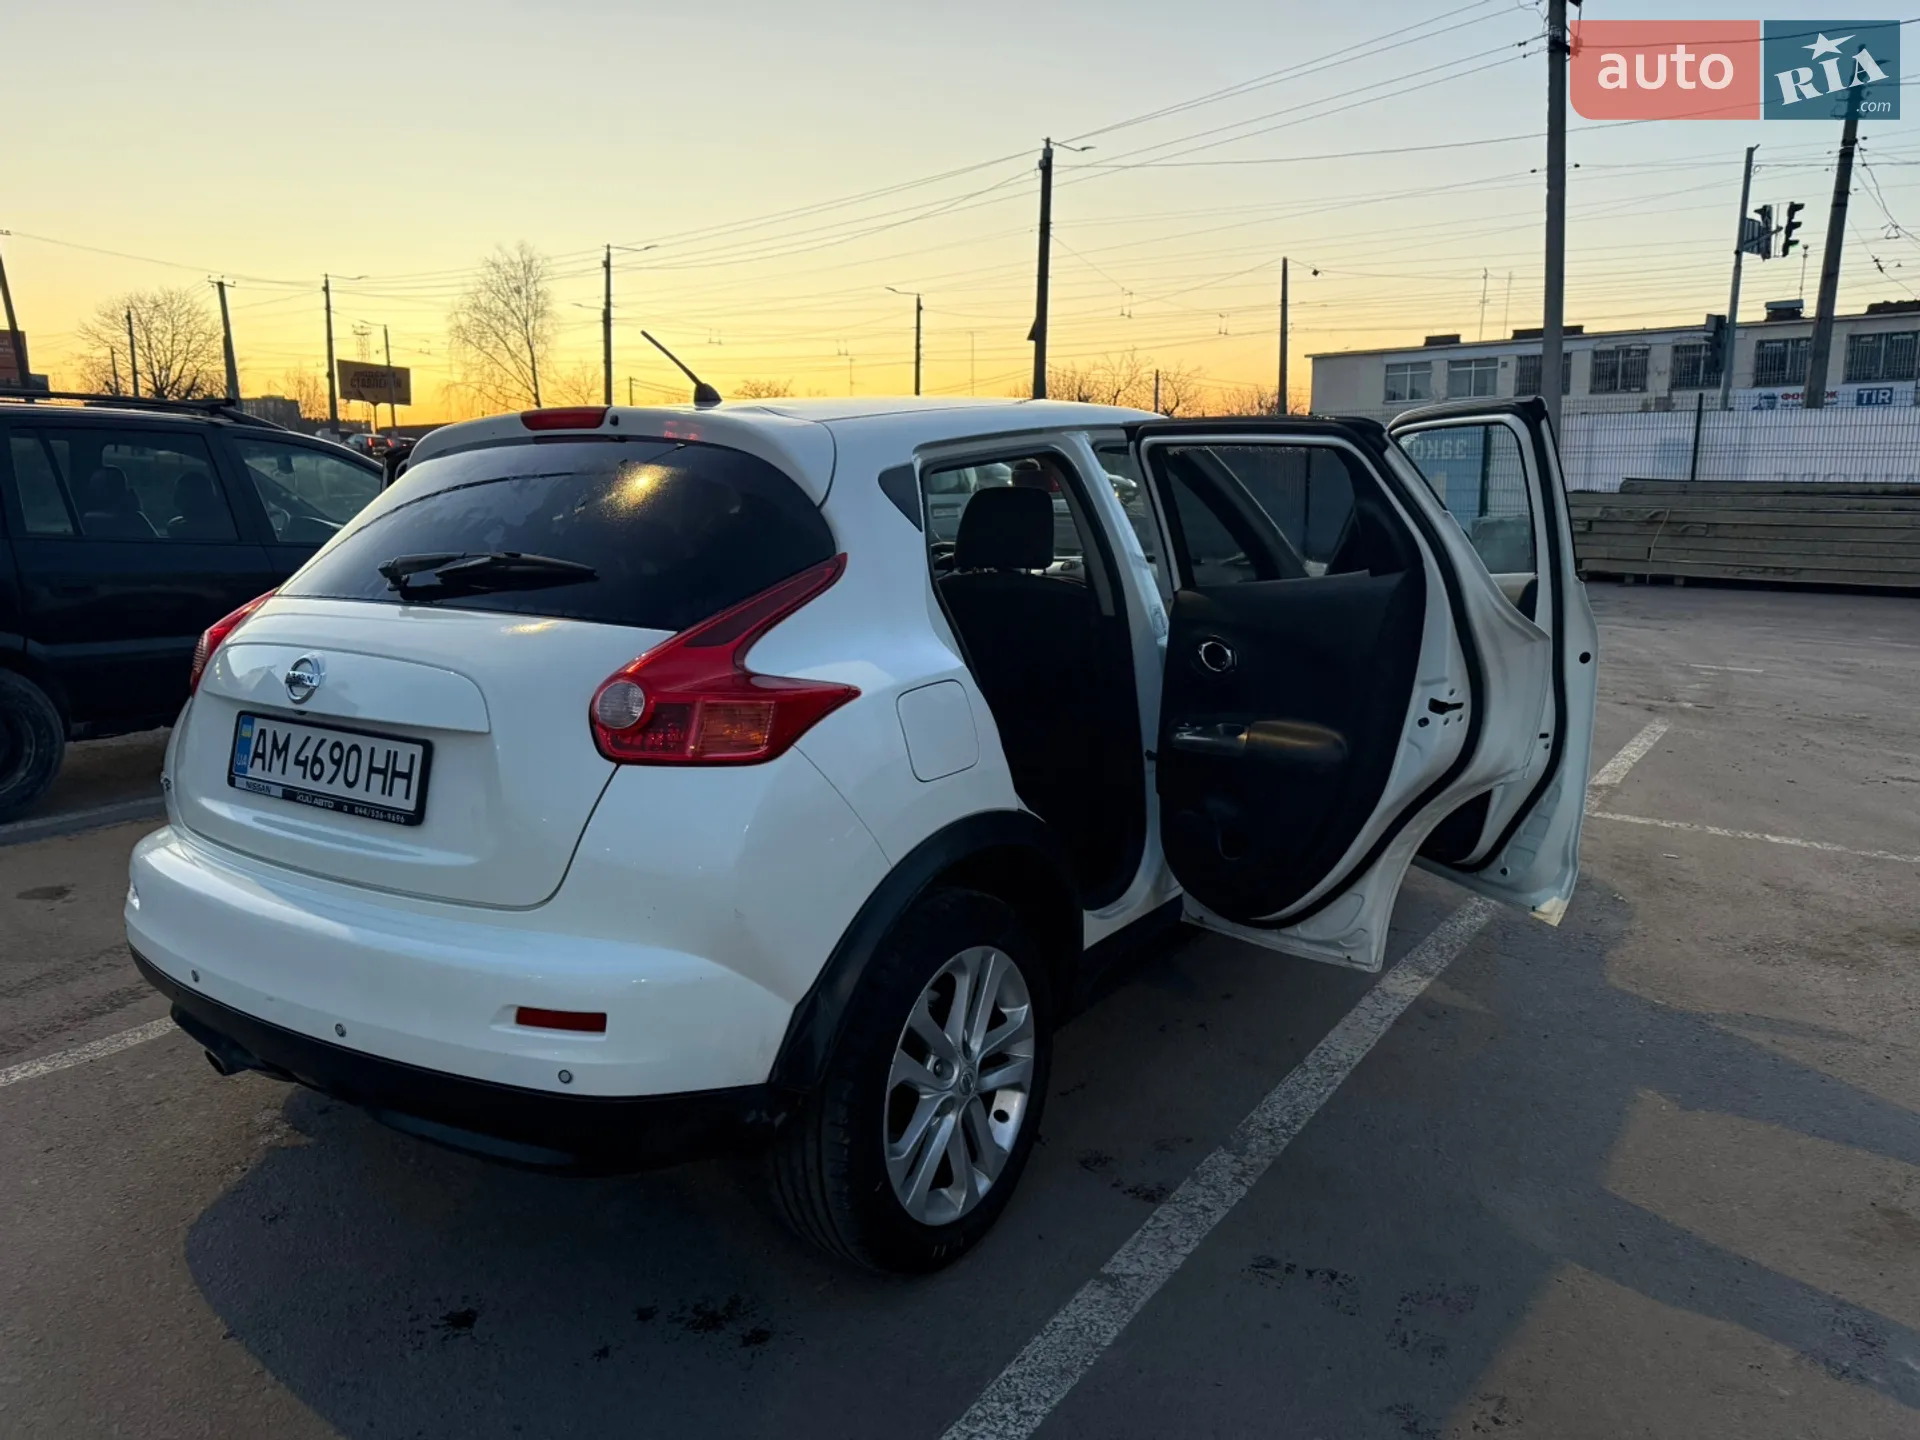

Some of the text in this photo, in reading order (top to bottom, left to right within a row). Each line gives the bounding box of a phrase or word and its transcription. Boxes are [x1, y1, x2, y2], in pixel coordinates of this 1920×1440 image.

[1859, 389, 1891, 405] TIR
[236, 753, 248, 767] UA
[294, 736, 362, 788] 4690
[245, 780, 272, 794] NISSAN
